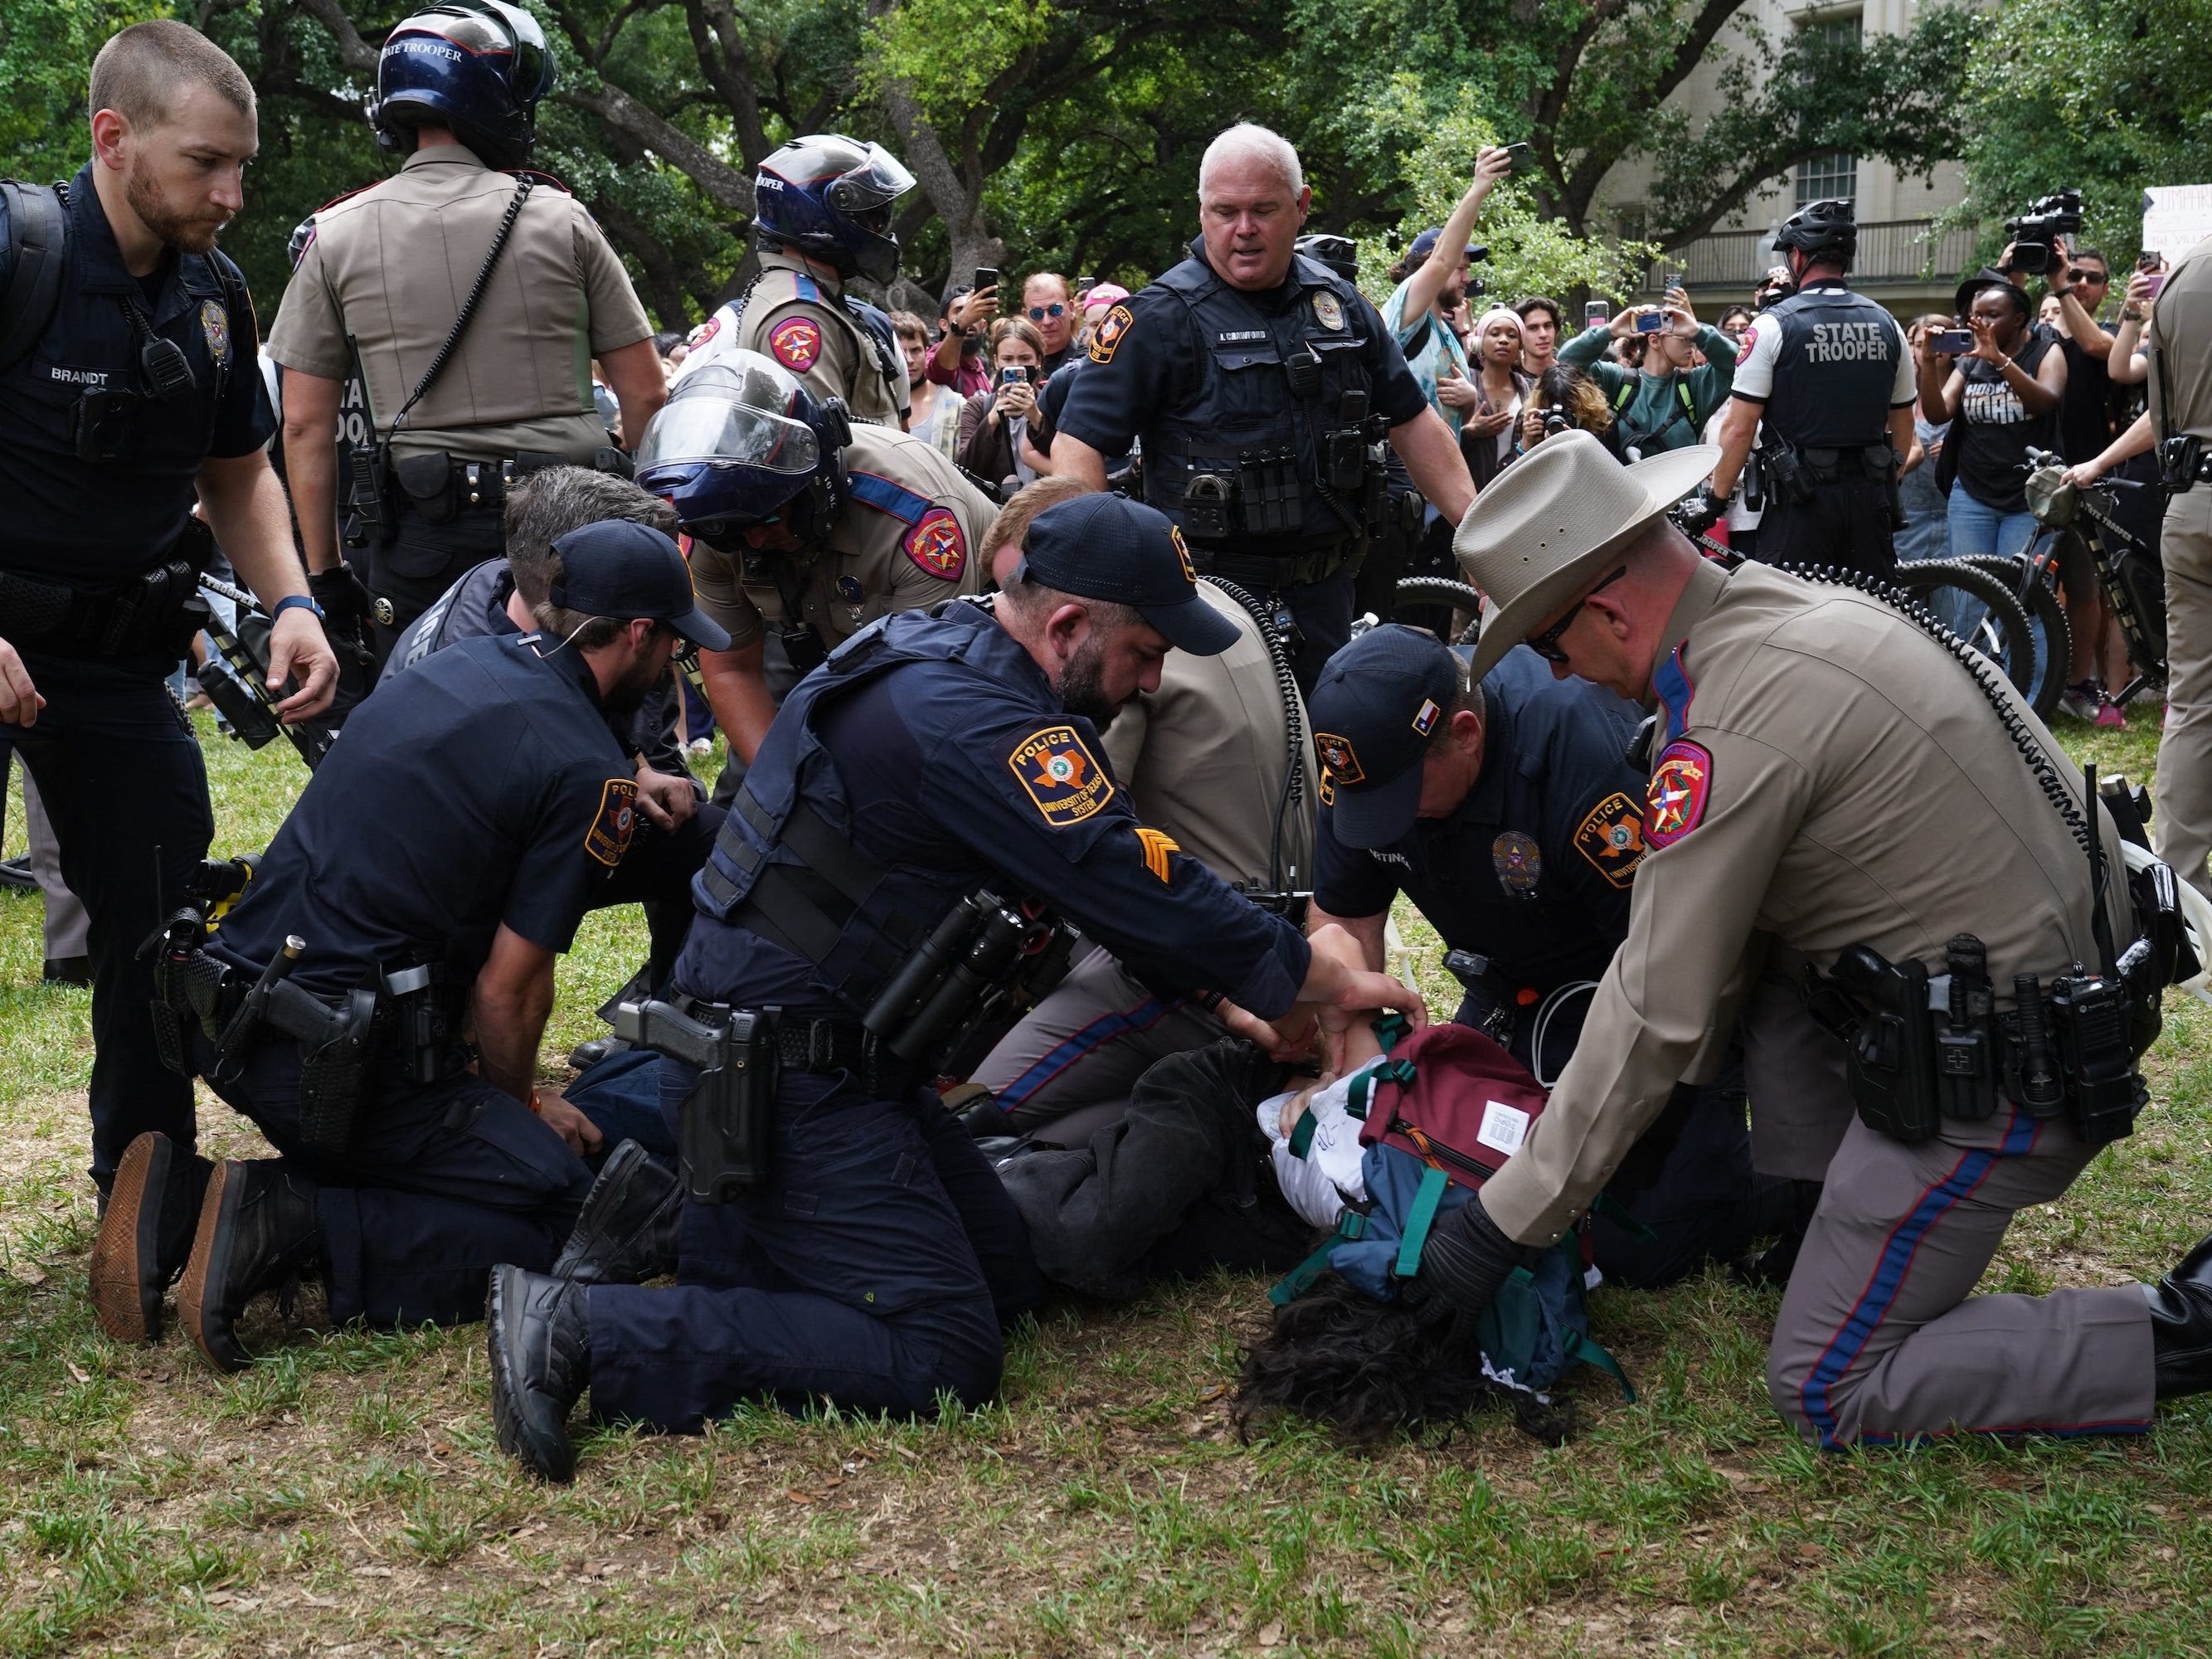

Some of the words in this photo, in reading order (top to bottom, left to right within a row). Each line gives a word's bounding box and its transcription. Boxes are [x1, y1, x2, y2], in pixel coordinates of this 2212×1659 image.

[403, 42, 462, 63] TROOPER
[1226, 331, 1266, 341] CRAWFORD
[1813, 323, 1882, 343] STATE
[1805, 341, 1888, 362] TROOPER
[51, 367, 109, 386] BRANDT
[1962, 392, 2034, 425] HORN
[2102, 516, 2132, 542] TROOPER
[206, 577, 256, 608] TROOPER
[1016, 732, 1070, 766] POLICE
[1080, 787, 1092, 801] OF
[1085, 773, 1102, 795] TEXAS
[1042, 794, 1082, 812] UNIVERSITY
[1072, 797, 1097, 816] SYSTEM
[1581, 798, 1623, 843] POLICE
[1610, 854, 1641, 878] UNIVERSITY
